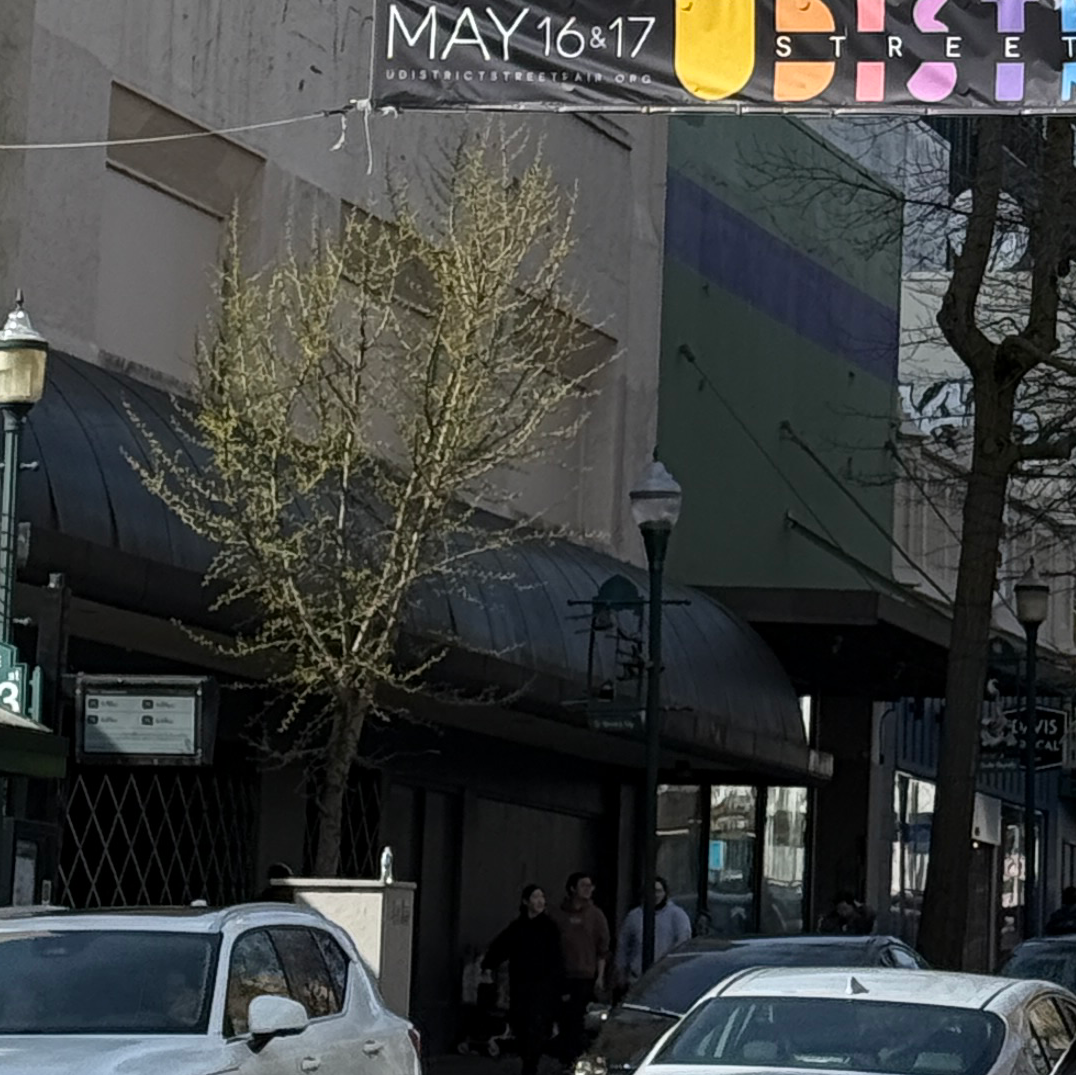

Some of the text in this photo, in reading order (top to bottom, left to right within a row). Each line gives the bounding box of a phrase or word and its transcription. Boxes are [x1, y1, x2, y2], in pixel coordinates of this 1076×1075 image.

[385, 4, 656, 61] MAY 16&17
[385, 69, 652, 84] UDISTRICTSTREETFAIRORG
[1011, 719, 1058, 735] DVIS
